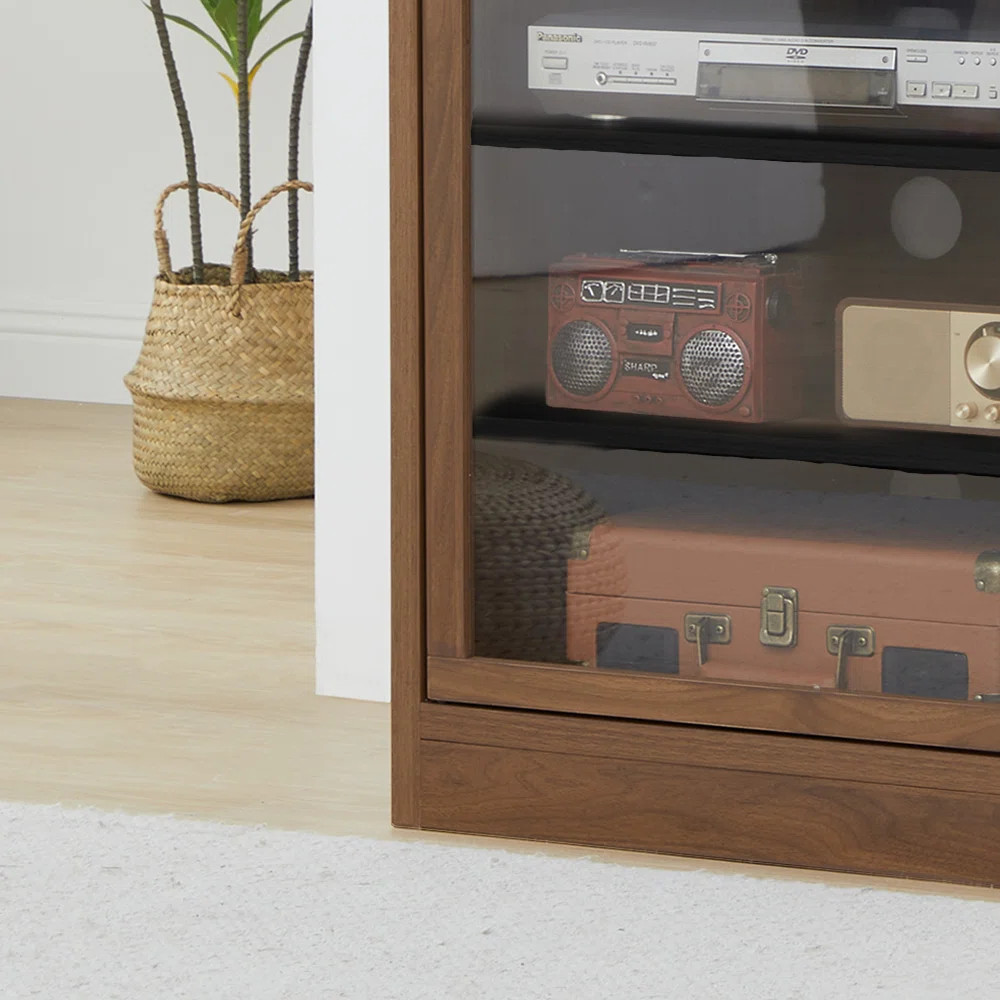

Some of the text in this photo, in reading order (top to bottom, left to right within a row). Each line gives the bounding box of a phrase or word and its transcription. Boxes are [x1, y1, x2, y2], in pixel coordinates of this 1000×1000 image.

[536, 31, 583, 43] Panasonic
[786, 47, 809, 55] DVD
[624, 361, 657, 372] SHARP
